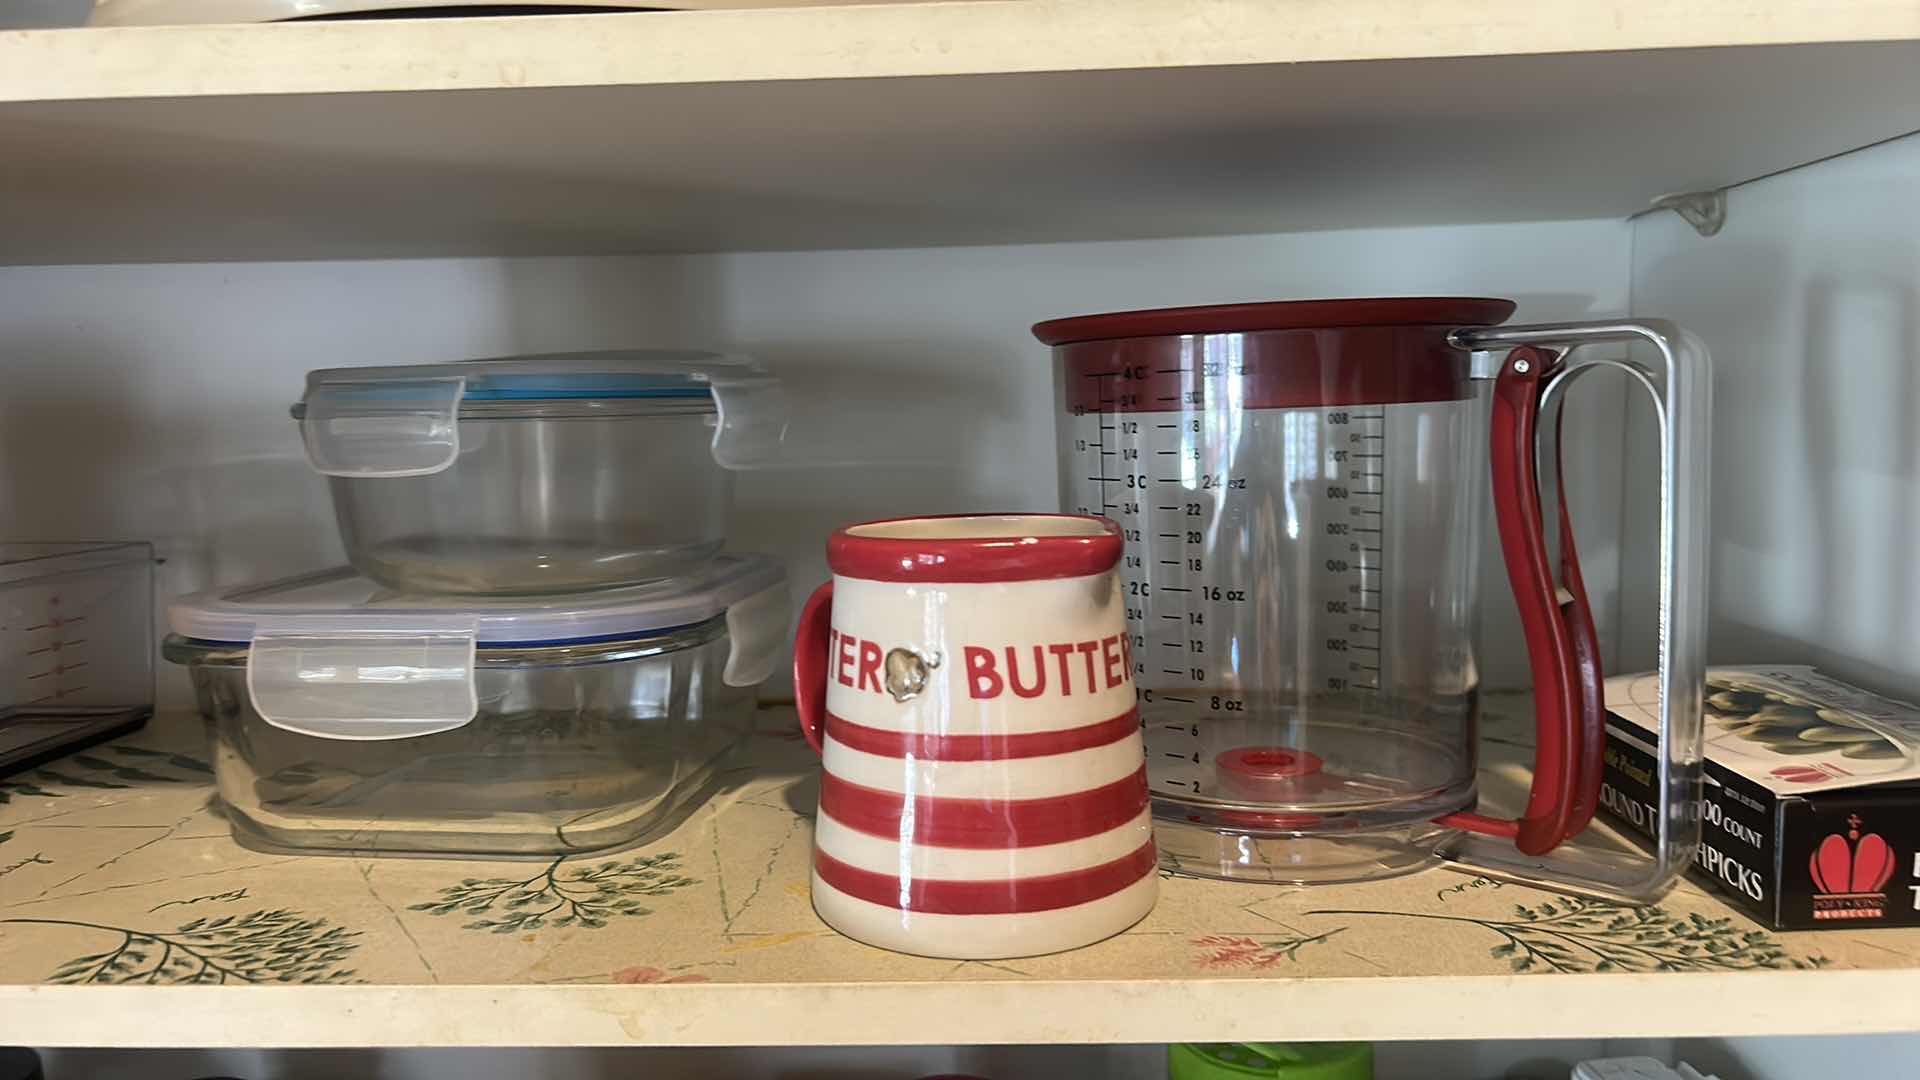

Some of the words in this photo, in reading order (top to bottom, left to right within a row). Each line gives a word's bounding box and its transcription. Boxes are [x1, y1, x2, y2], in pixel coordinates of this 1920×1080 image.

[1121, 422, 1138, 434] 1/2
[1123, 449, 1138, 461] 1/4
[1202, 475, 1223, 489] 24
[1124, 503, 1139, 515] 3/4
[1186, 503, 1201, 516] 22
[1125, 529, 1141, 542] 1/2
[1186, 531, 1202, 544] 20
[1126, 556, 1141, 568] 1/4
[1188, 559, 1202, 571] 18
[1202, 586, 1221, 601] 16
[1227, 590, 1245, 602] oz
[1127, 608, 1142, 620] 3/4
[1189, 612, 1203, 625] 14
[1190, 640, 1204, 653] 12
[830, 629, 883, 694] TER
[963, 631, 1133, 700] BUTTER
[1191, 668, 1205, 681] 10
[1210, 696, 1220, 710] 8
[1225, 701, 1243, 712] oz
[1191, 724, 1199, 737] 6
[1192, 752, 1200, 764] 4
[1192, 781, 1201, 793] 2
[1600, 783, 1645, 826] OUND
[1723, 817, 1763, 849] COUNT
